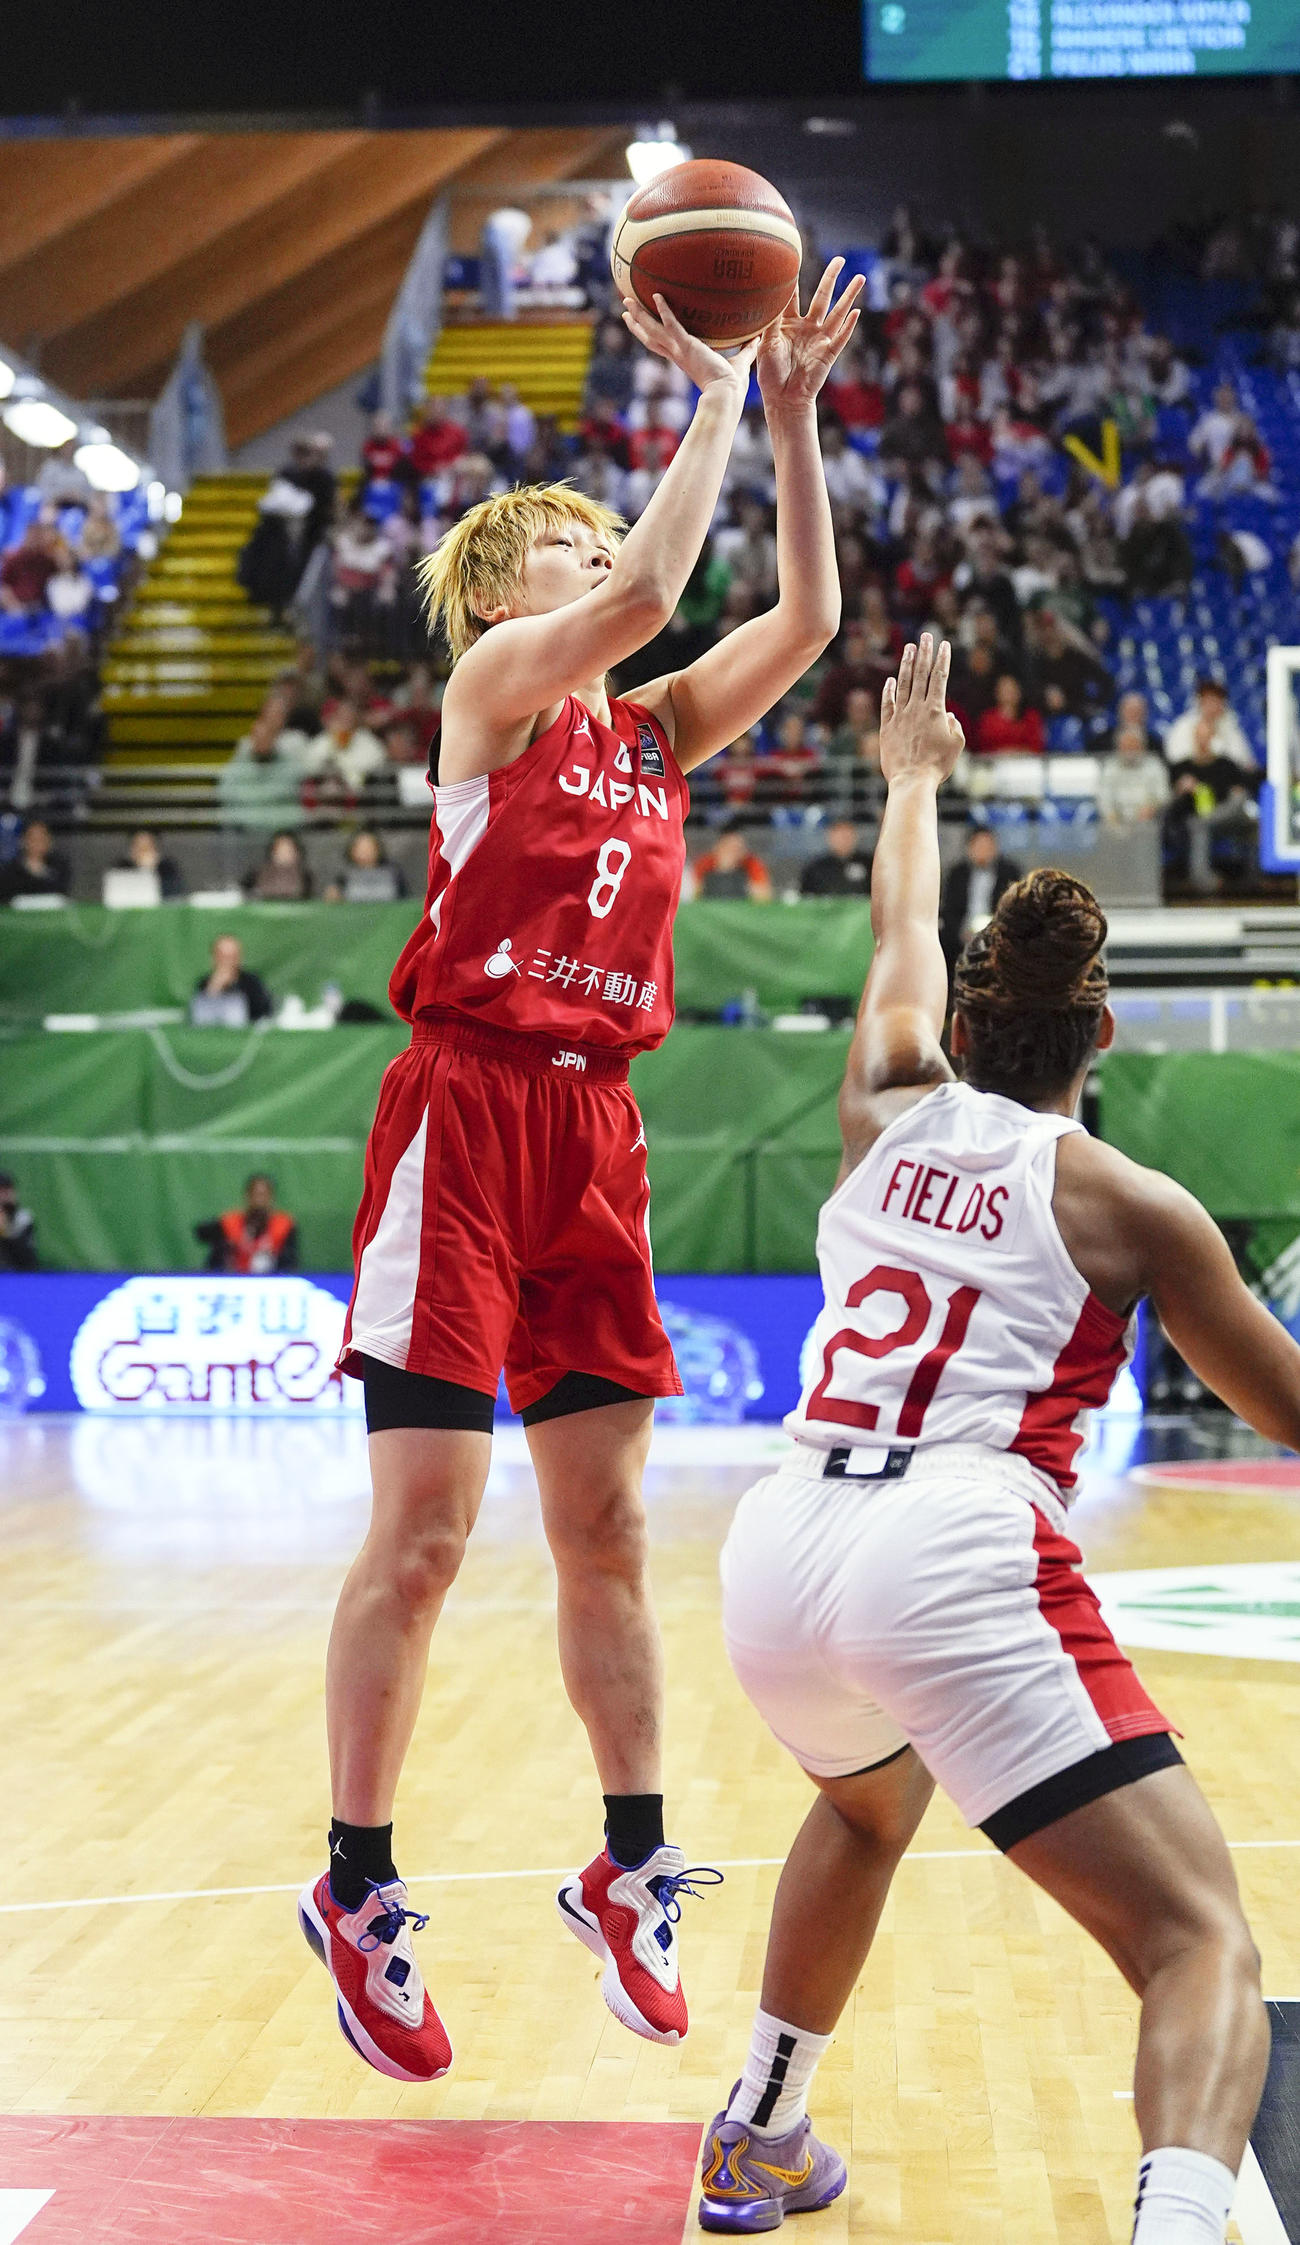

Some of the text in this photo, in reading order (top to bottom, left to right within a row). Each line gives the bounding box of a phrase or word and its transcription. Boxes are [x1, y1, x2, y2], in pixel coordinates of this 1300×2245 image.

[713, 259, 754, 279] FIBA
[559, 764, 669, 820] JAPN
[587, 837, 632, 919] 8
[527, 948, 659, 1012] 三井不動産
[551, 1049, 587, 1072] JPN
[881, 1159, 1009, 1241] FIELDS
[805, 1264, 983, 1438] 21
